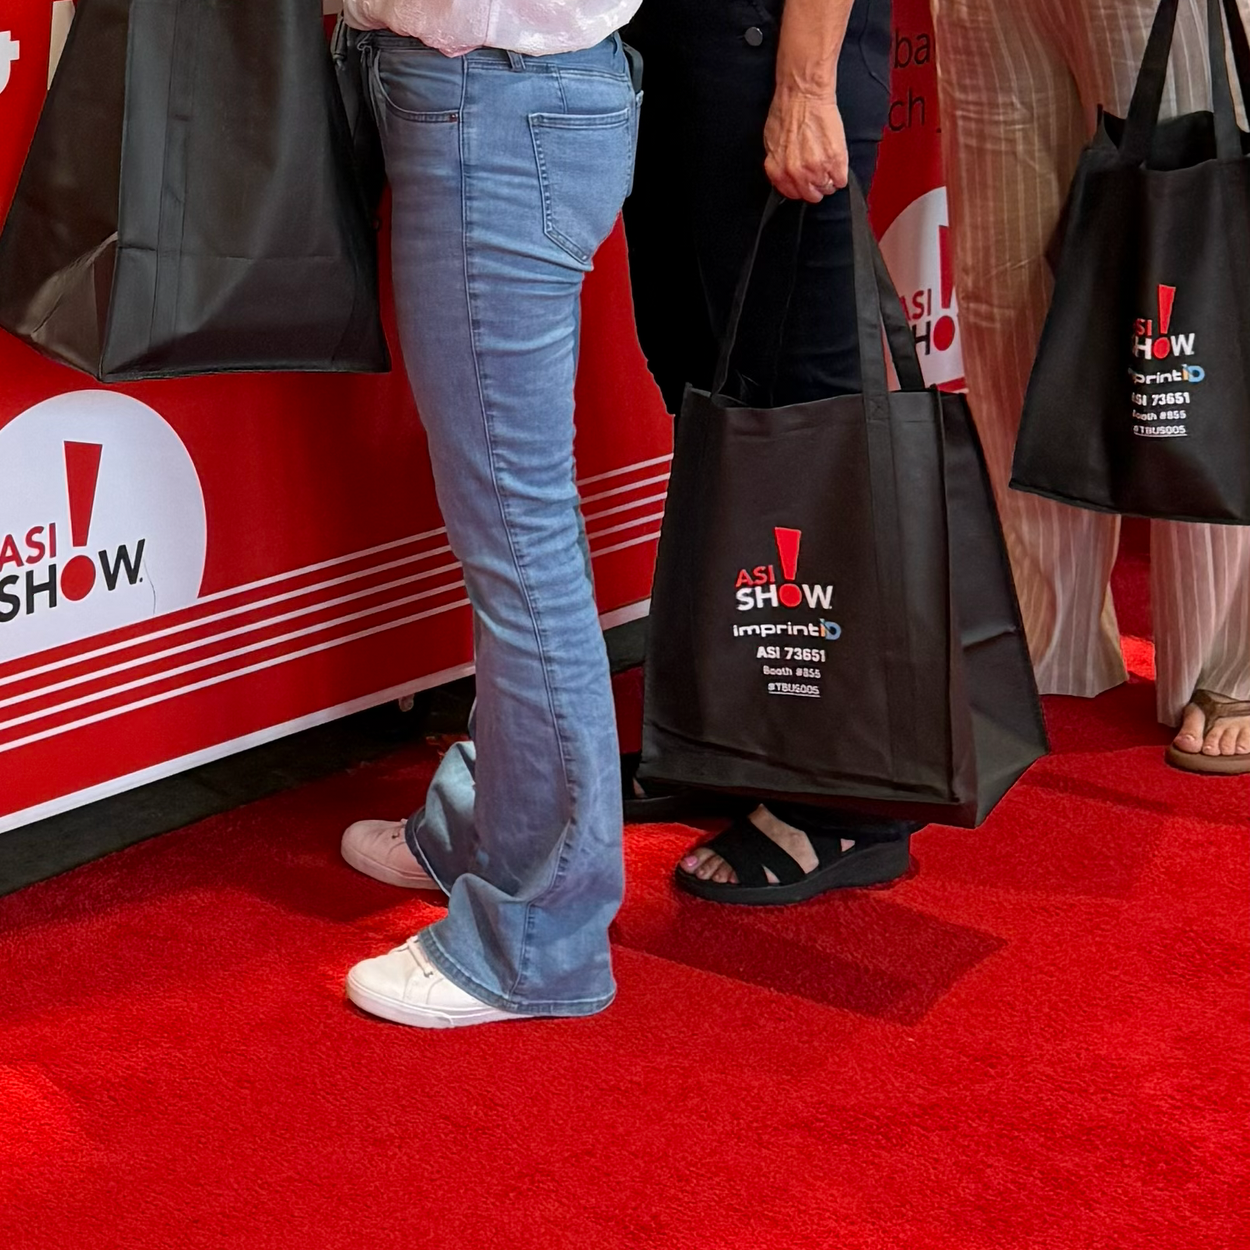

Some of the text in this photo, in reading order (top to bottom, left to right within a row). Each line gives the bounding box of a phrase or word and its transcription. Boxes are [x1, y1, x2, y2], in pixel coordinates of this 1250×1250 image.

[893, 28, 931, 69] ba
[1133, 318, 1152, 336] SI
[1132, 333, 1195, 360] HOW
[1152, 392, 1190, 406] 73651
[735, 564, 775, 588] ASI
[736, 583, 833, 611] SHOW
[756, 646, 826, 662] ASI 73651
[763, 665, 792, 676] Booth
